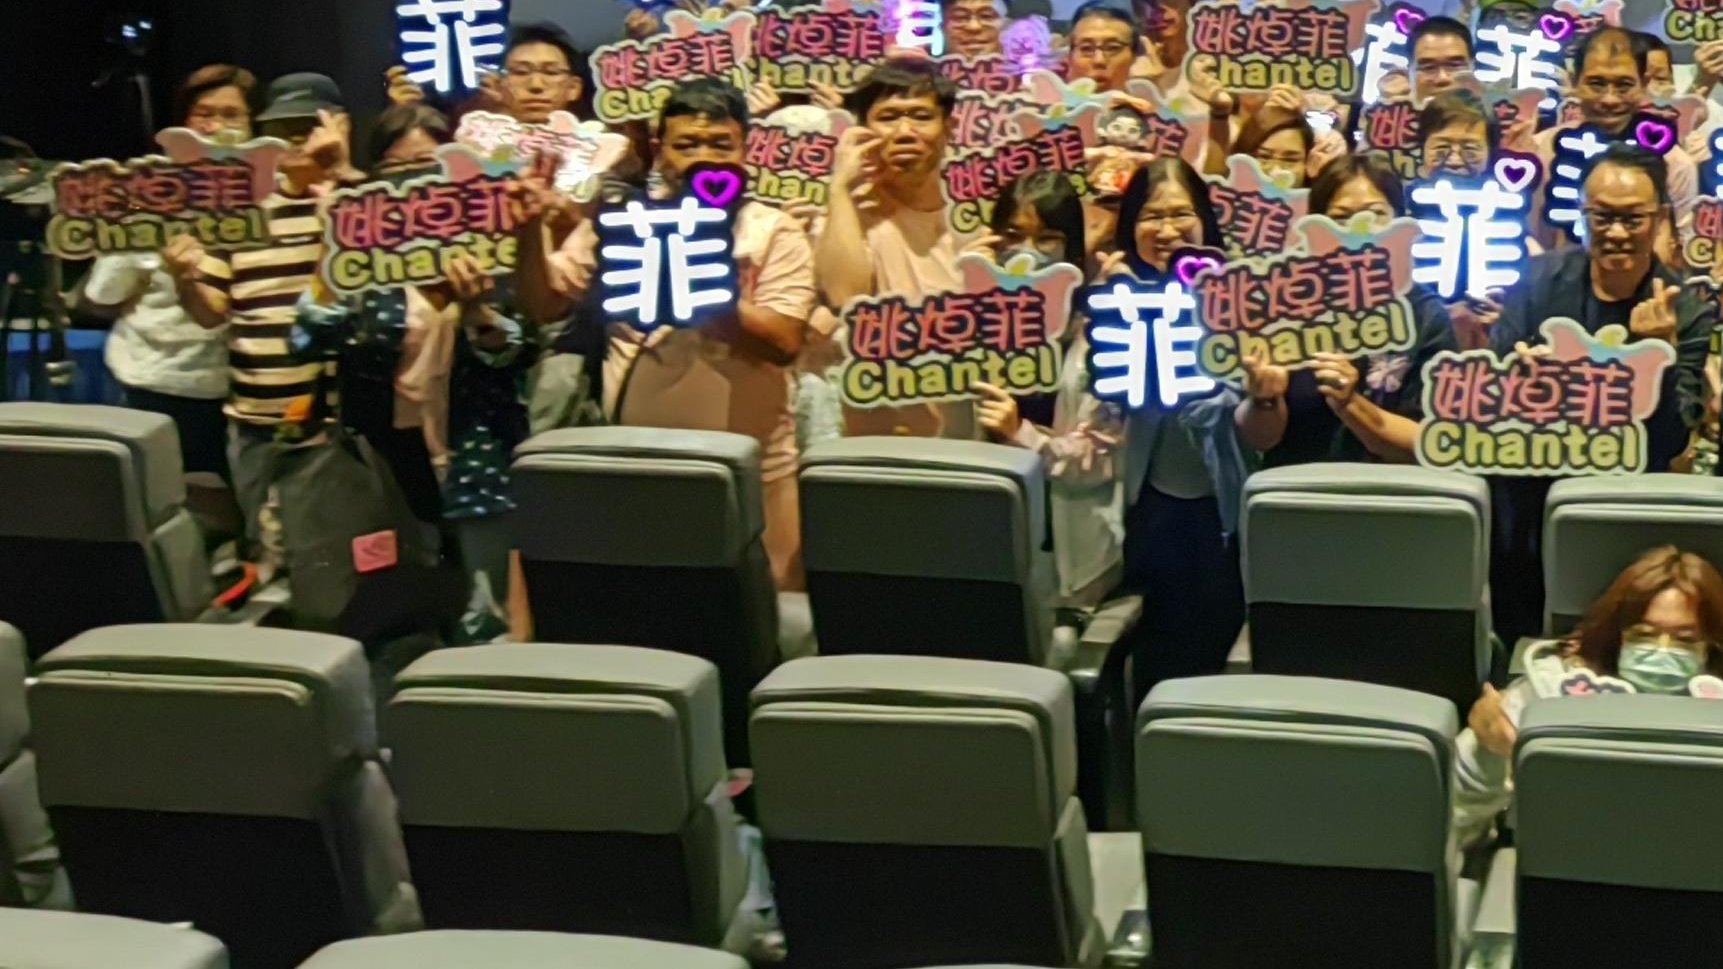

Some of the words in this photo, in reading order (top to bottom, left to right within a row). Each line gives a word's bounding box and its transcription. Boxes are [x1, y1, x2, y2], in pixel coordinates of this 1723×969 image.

[601, 32, 732, 89] 姚焯菲
[1196, 8, 1347, 58] 姚焯菲
[1474, 24, 1560, 110] 菲
[748, 127, 838, 175] 姚焯
[332, 234, 518, 287] Chante
[599, 196, 732, 323] 菲
[1411, 179, 1524, 298] 菲
[852, 289, 1044, 359] 姚焯菲
[1203, 250, 1391, 331] 姚焯菲
[848, 345, 1055, 399] Chantel
[1088, 281, 1216, 407] 菲
[1205, 304, 1407, 373] Chantel
[1433, 361, 1634, 428] 姚焯菲
[1423, 422, 1638, 468] Chantel
